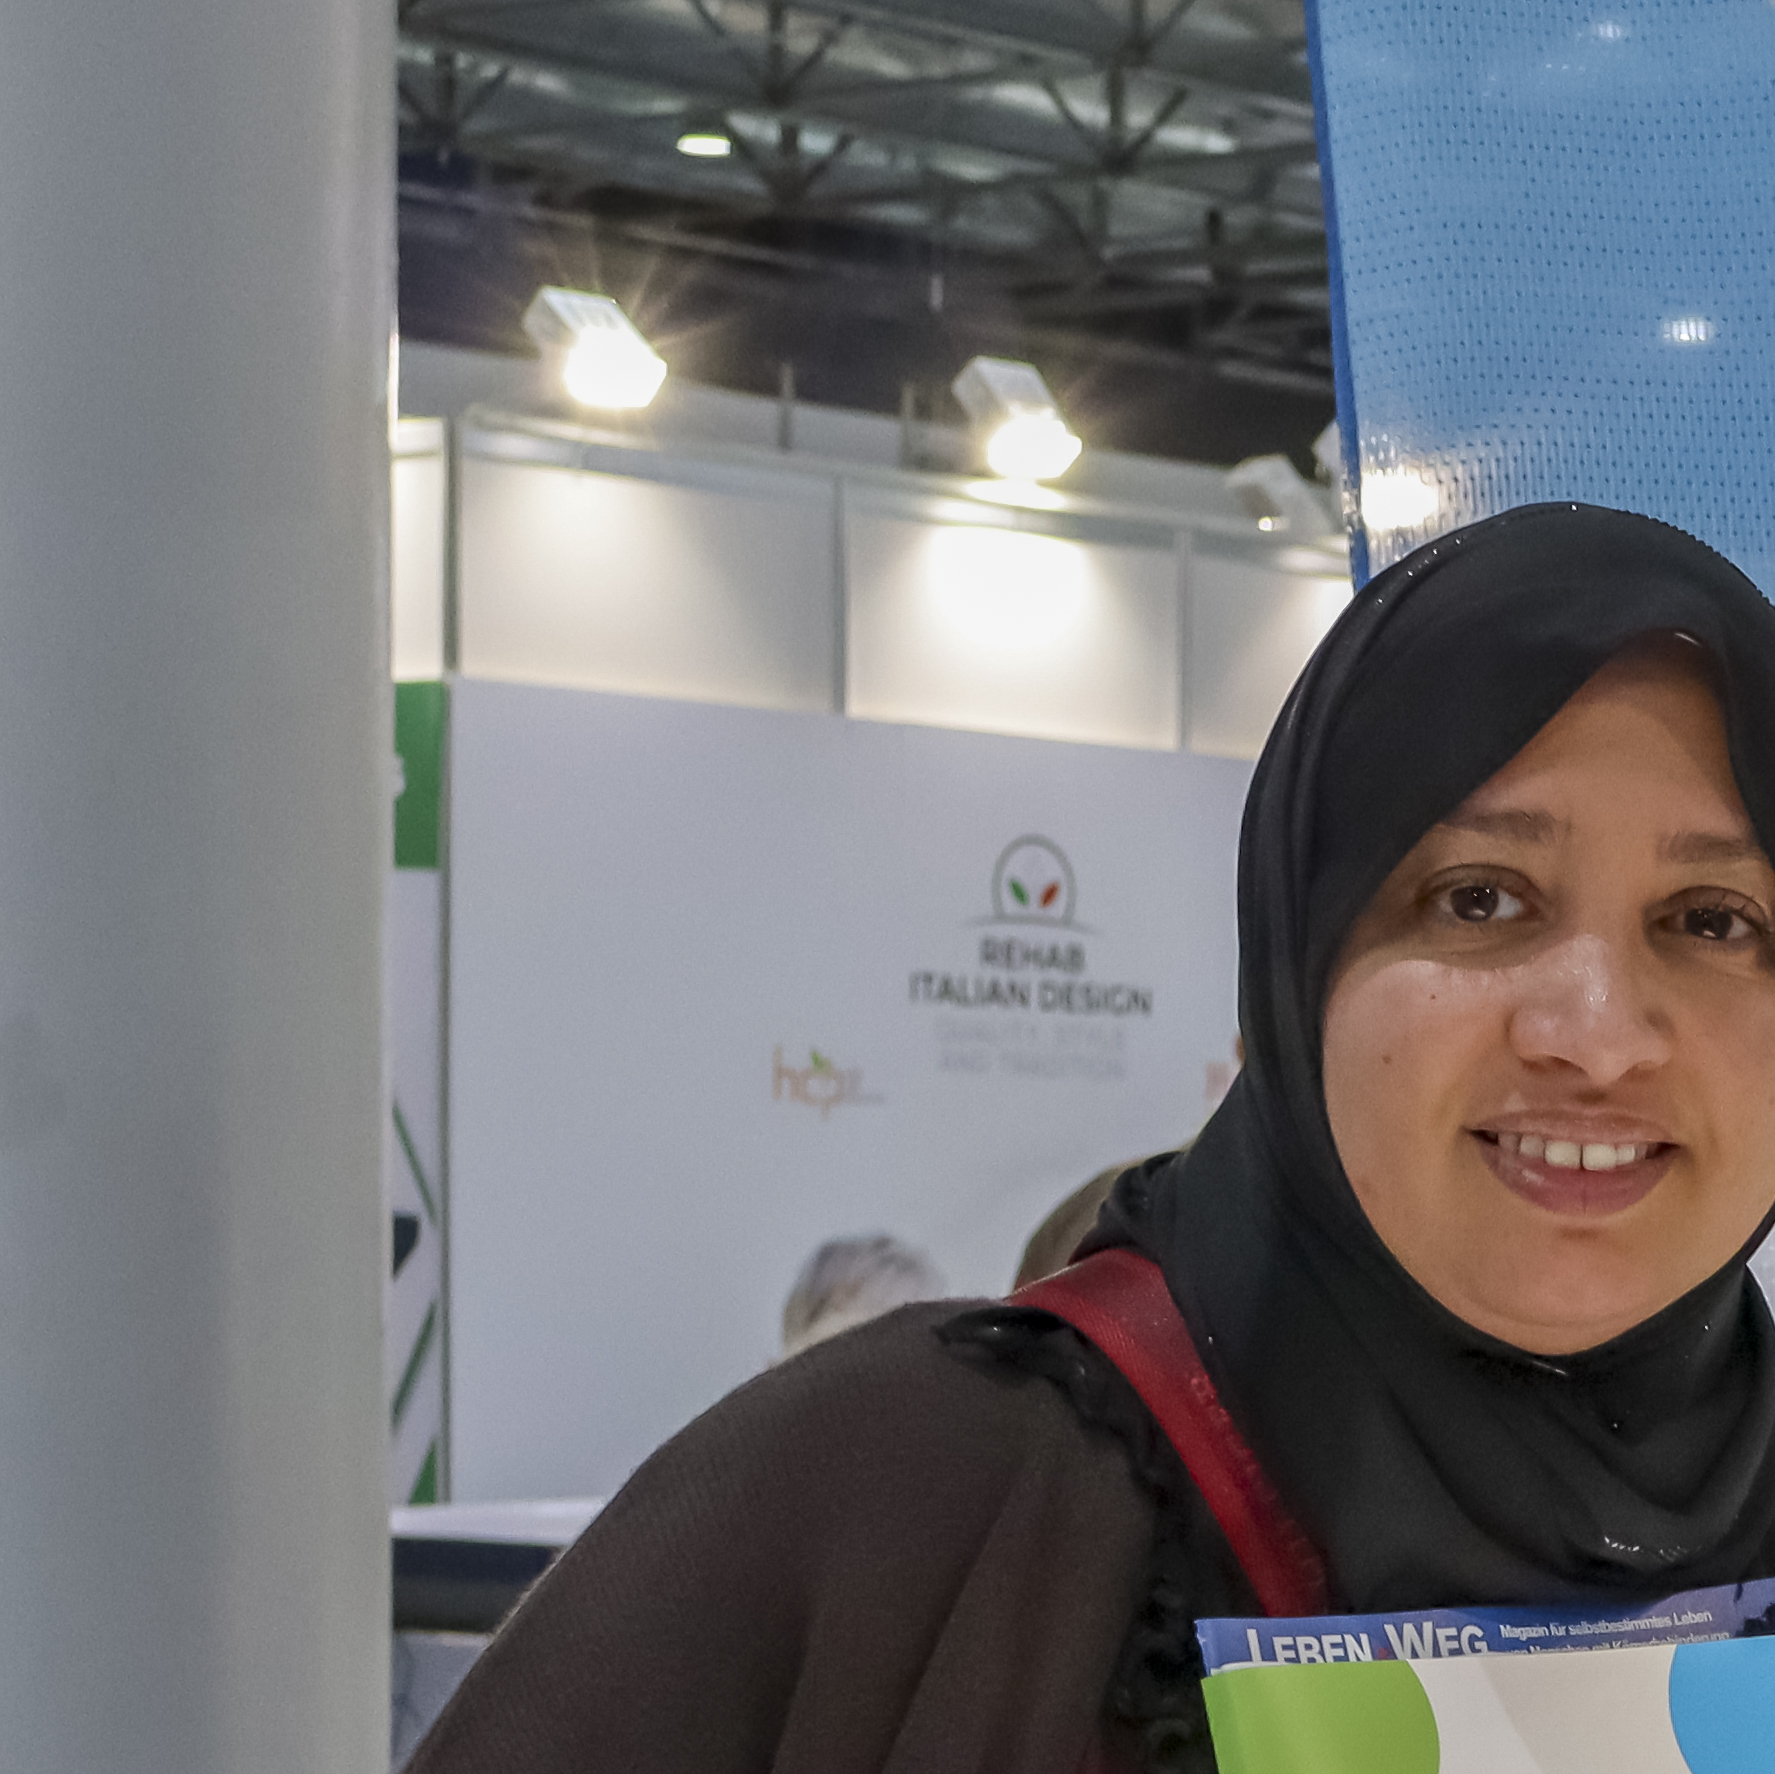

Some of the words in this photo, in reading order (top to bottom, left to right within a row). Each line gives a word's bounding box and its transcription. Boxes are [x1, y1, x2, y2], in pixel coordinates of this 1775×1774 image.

[980, 935, 1086, 973] REHAB
[908, 970, 1030, 1009] ITALIAN
[1038, 980, 1154, 1018] DESIGN
